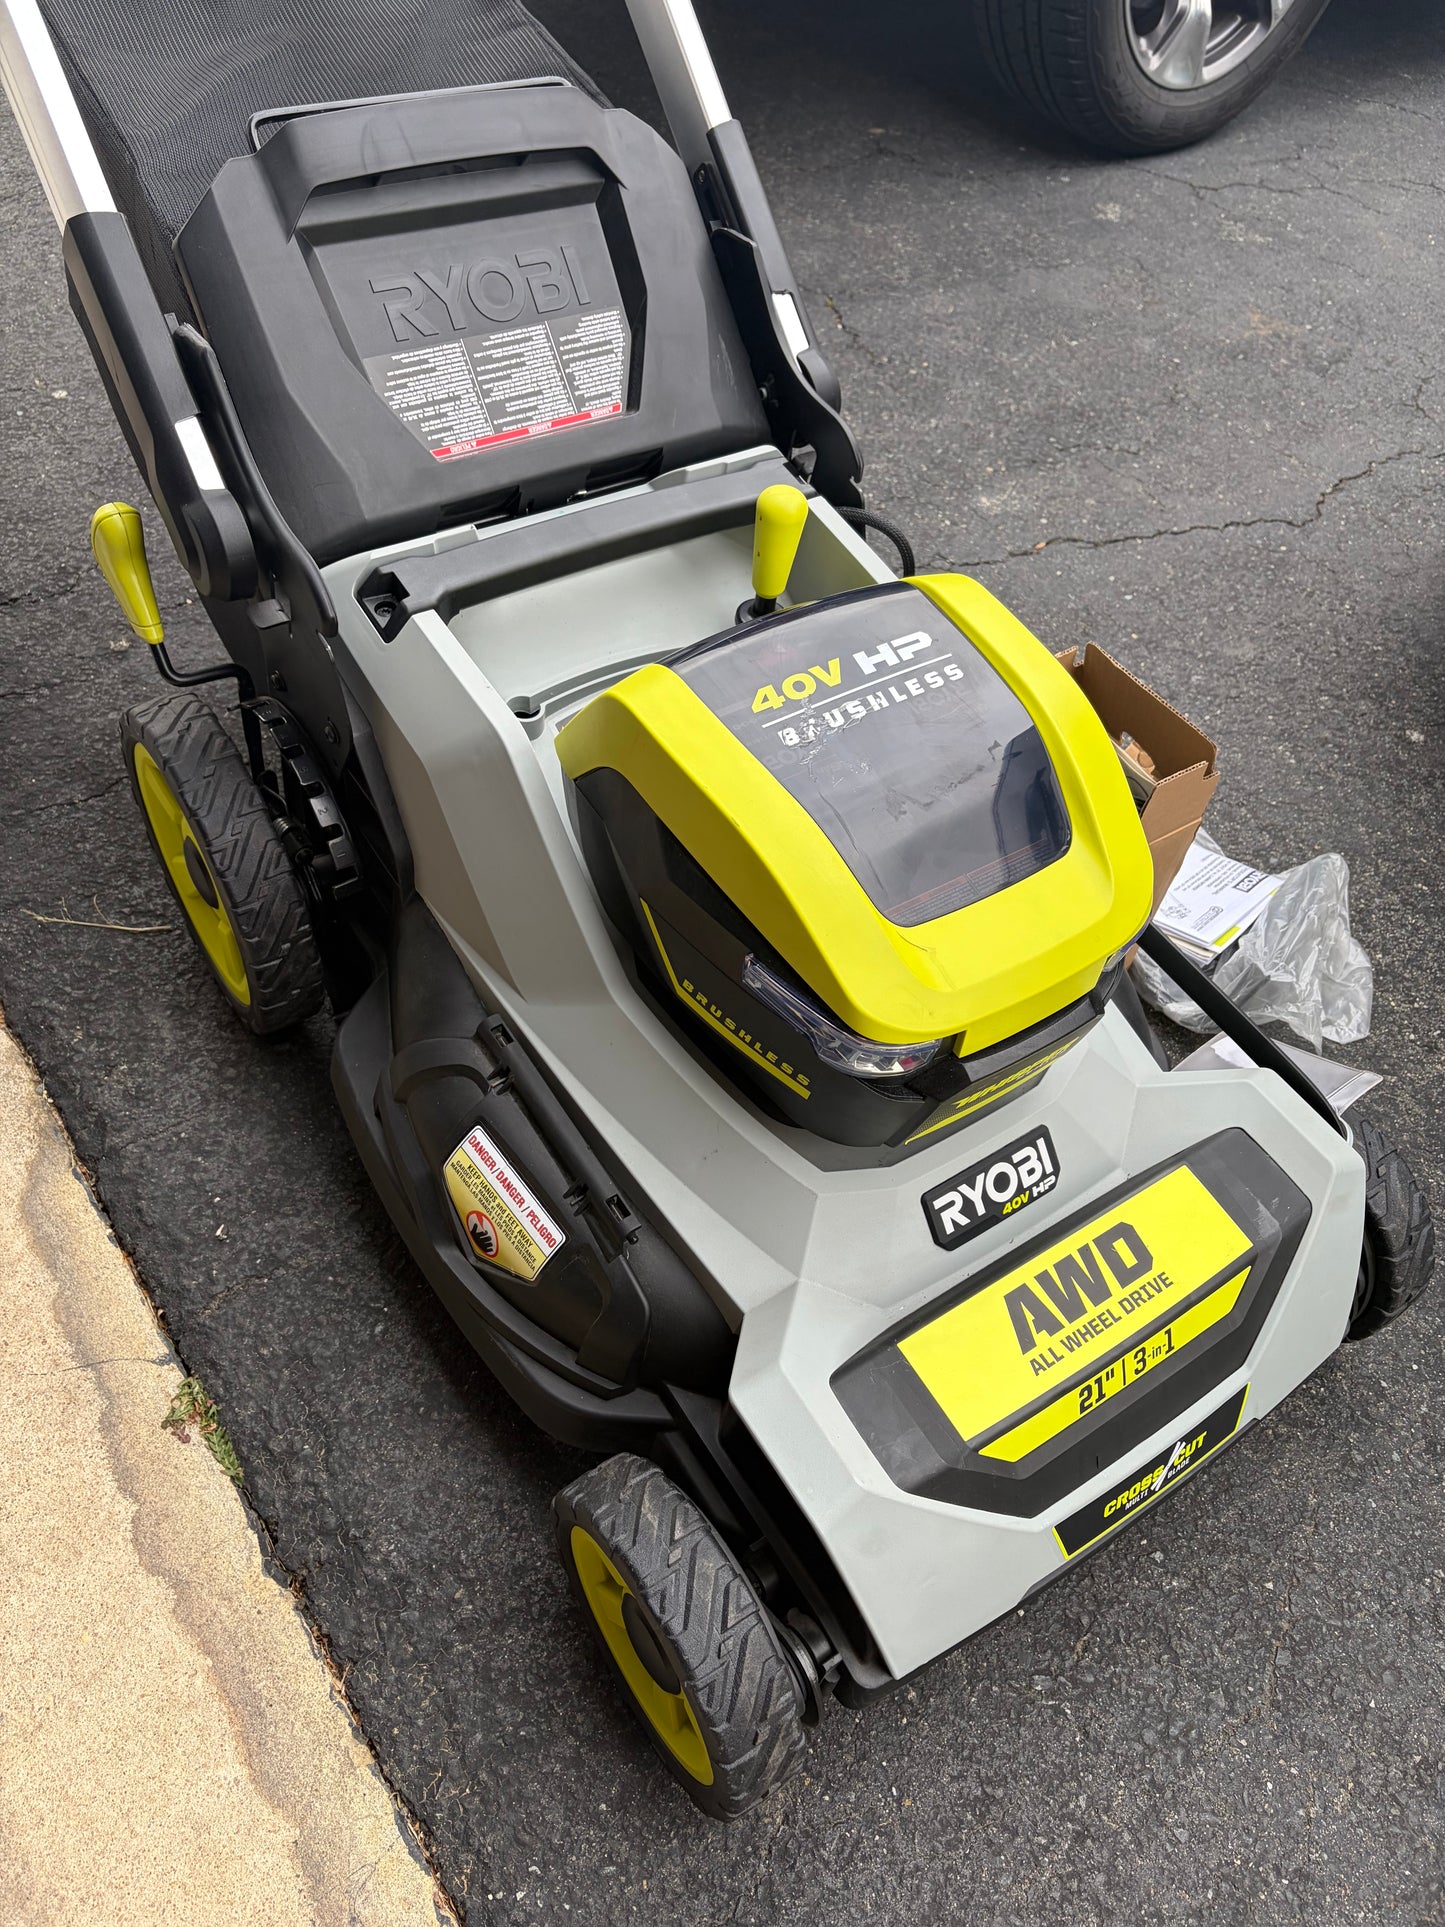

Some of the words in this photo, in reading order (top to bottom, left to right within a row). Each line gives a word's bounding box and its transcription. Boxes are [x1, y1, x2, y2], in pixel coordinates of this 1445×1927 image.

[368, 244, 591, 342] RYOBI
[751, 657, 842, 714] 40V
[852, 630, 933, 675] HP
[681, 979, 811, 1087] BRUSHLESS
[467, 1135, 497, 1171] DANGER
[495, 1170, 526, 1209] DANGER
[526, 1209, 557, 1249] PELIGRO
[467, 1163, 482, 1180] KEEP
[479, 1179, 498, 1203] HANDS
[495, 1202, 507, 1215] and
[505, 1213, 520, 1230] FEET
[516, 1229, 534, 1248] AWAY
[932, 1137, 1054, 1236] RYOBI
[1002, 1190, 1030, 1215] 40V
[1031, 1175, 1056, 1198] HP
[515, 1245, 536, 1272] DISTANCIA
[516, 1238, 537, 1264] DISTANCE
[1003, 1221, 1153, 1356] AWD
[1029, 1347, 1065, 1377] ALL
[1059, 1308, 1123, 1354] WHEEL
[1117, 1271, 1174, 1315] DRIVE
[1078, 1367, 1115, 1415] 21"
[1103, 1464, 1165, 1518] CROSS
[1124, 1488, 1149, 1510] MULTI
[1167, 1456, 1191, 1479] BLADE
